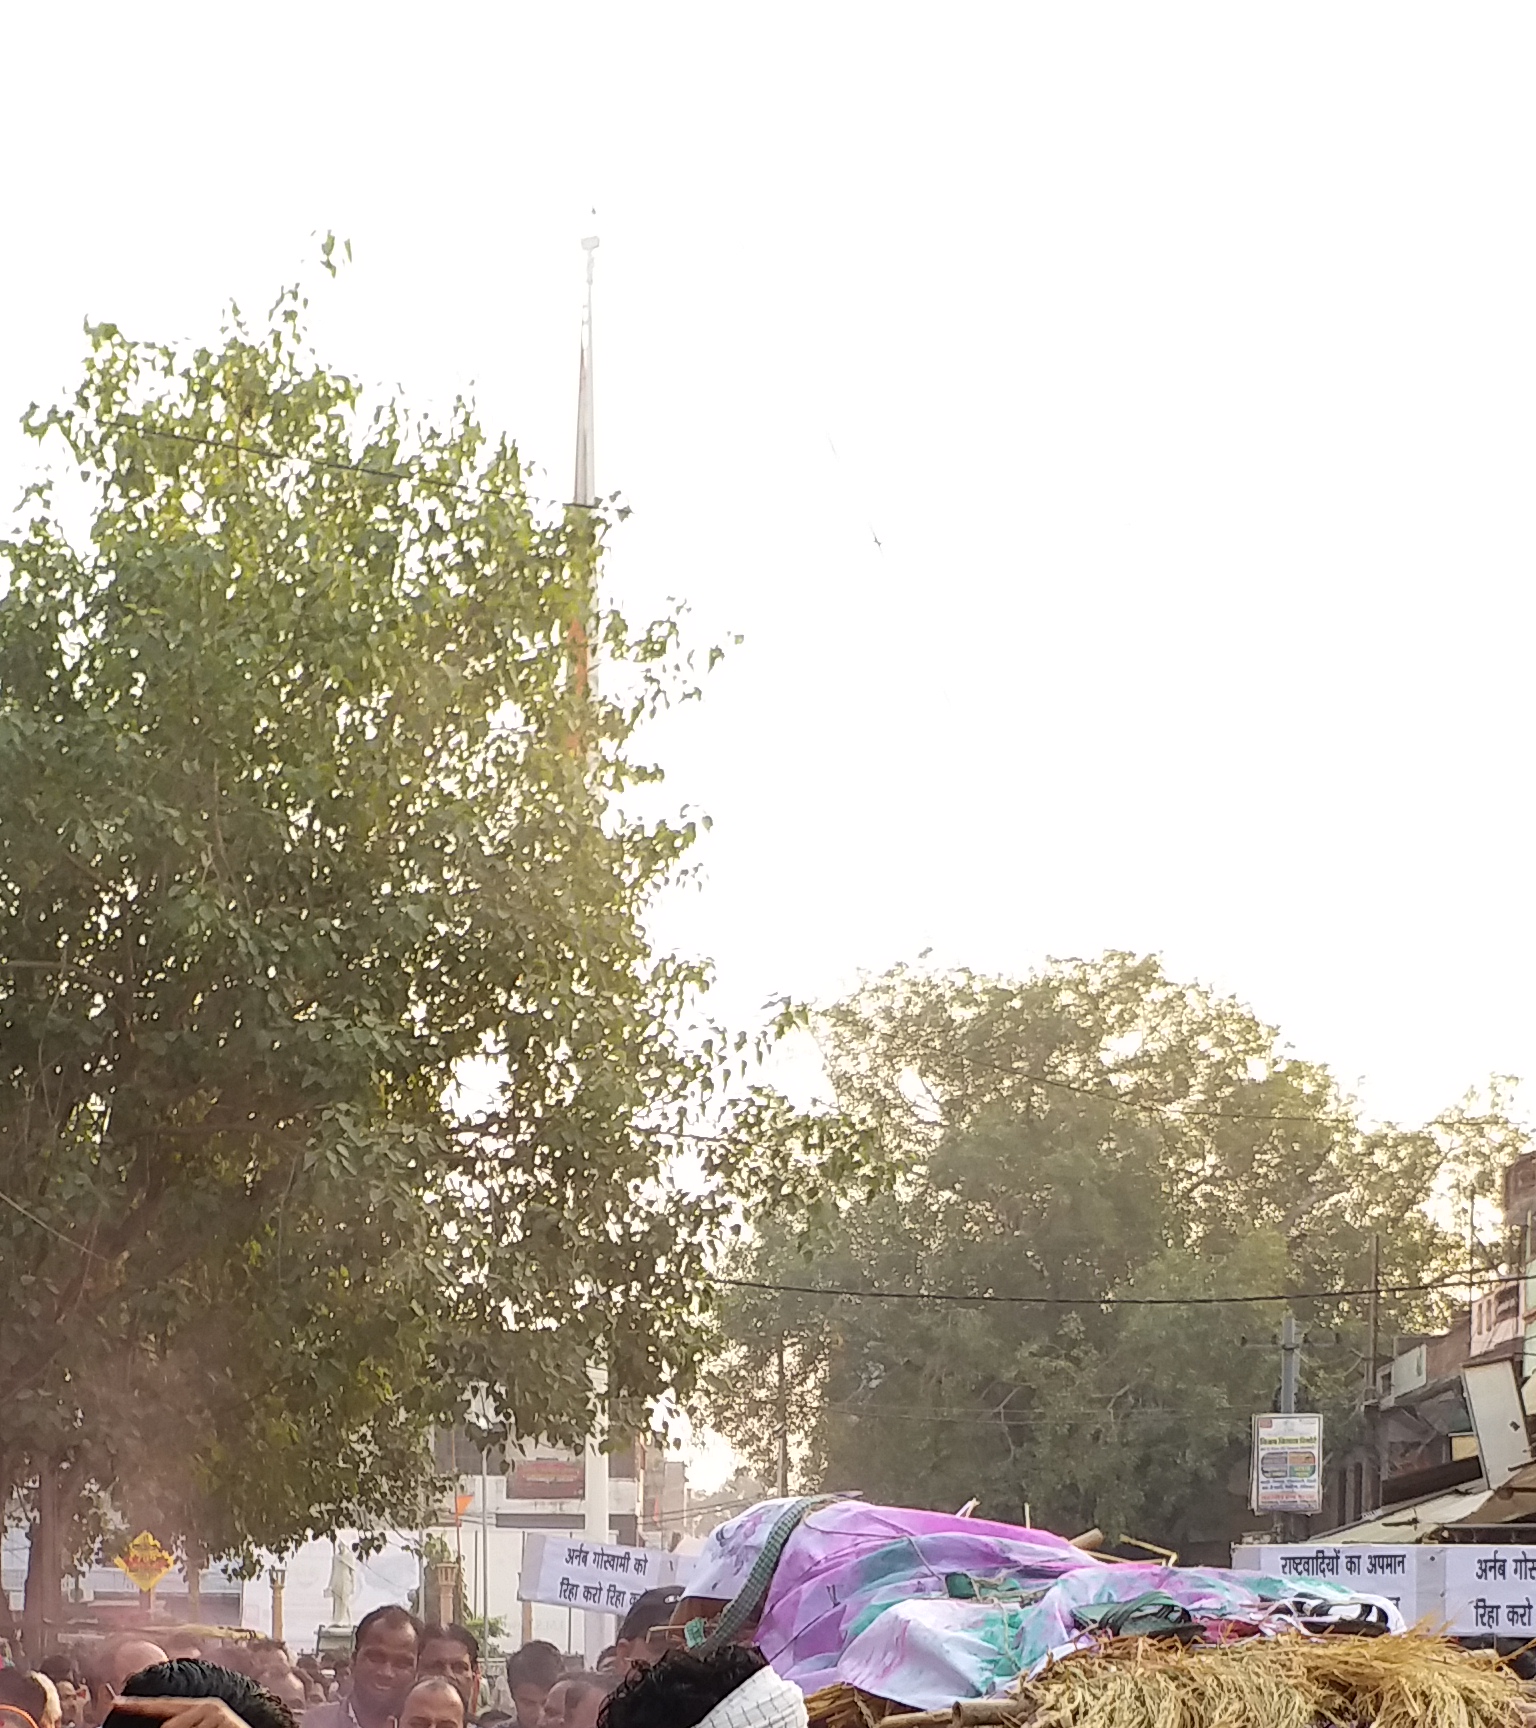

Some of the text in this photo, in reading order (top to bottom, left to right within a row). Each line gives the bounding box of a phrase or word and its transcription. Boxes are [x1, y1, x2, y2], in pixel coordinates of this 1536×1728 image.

[565, 1543, 648, 1575] अर्नब गोस्वामी को
[1345, 1555, 1361, 1575] का
[1367, 1554, 1406, 1574] अपमान
[1476, 1550, 1507, 1580] अर्नब
[559, 1577, 579, 1602] रिहा
[583, 1581, 603, 1604] करो
[606, 1584, 626, 1608] रिहा
[1474, 1598, 1501, 1629] रिहा
[1506, 1597, 1533, 1626] करो
